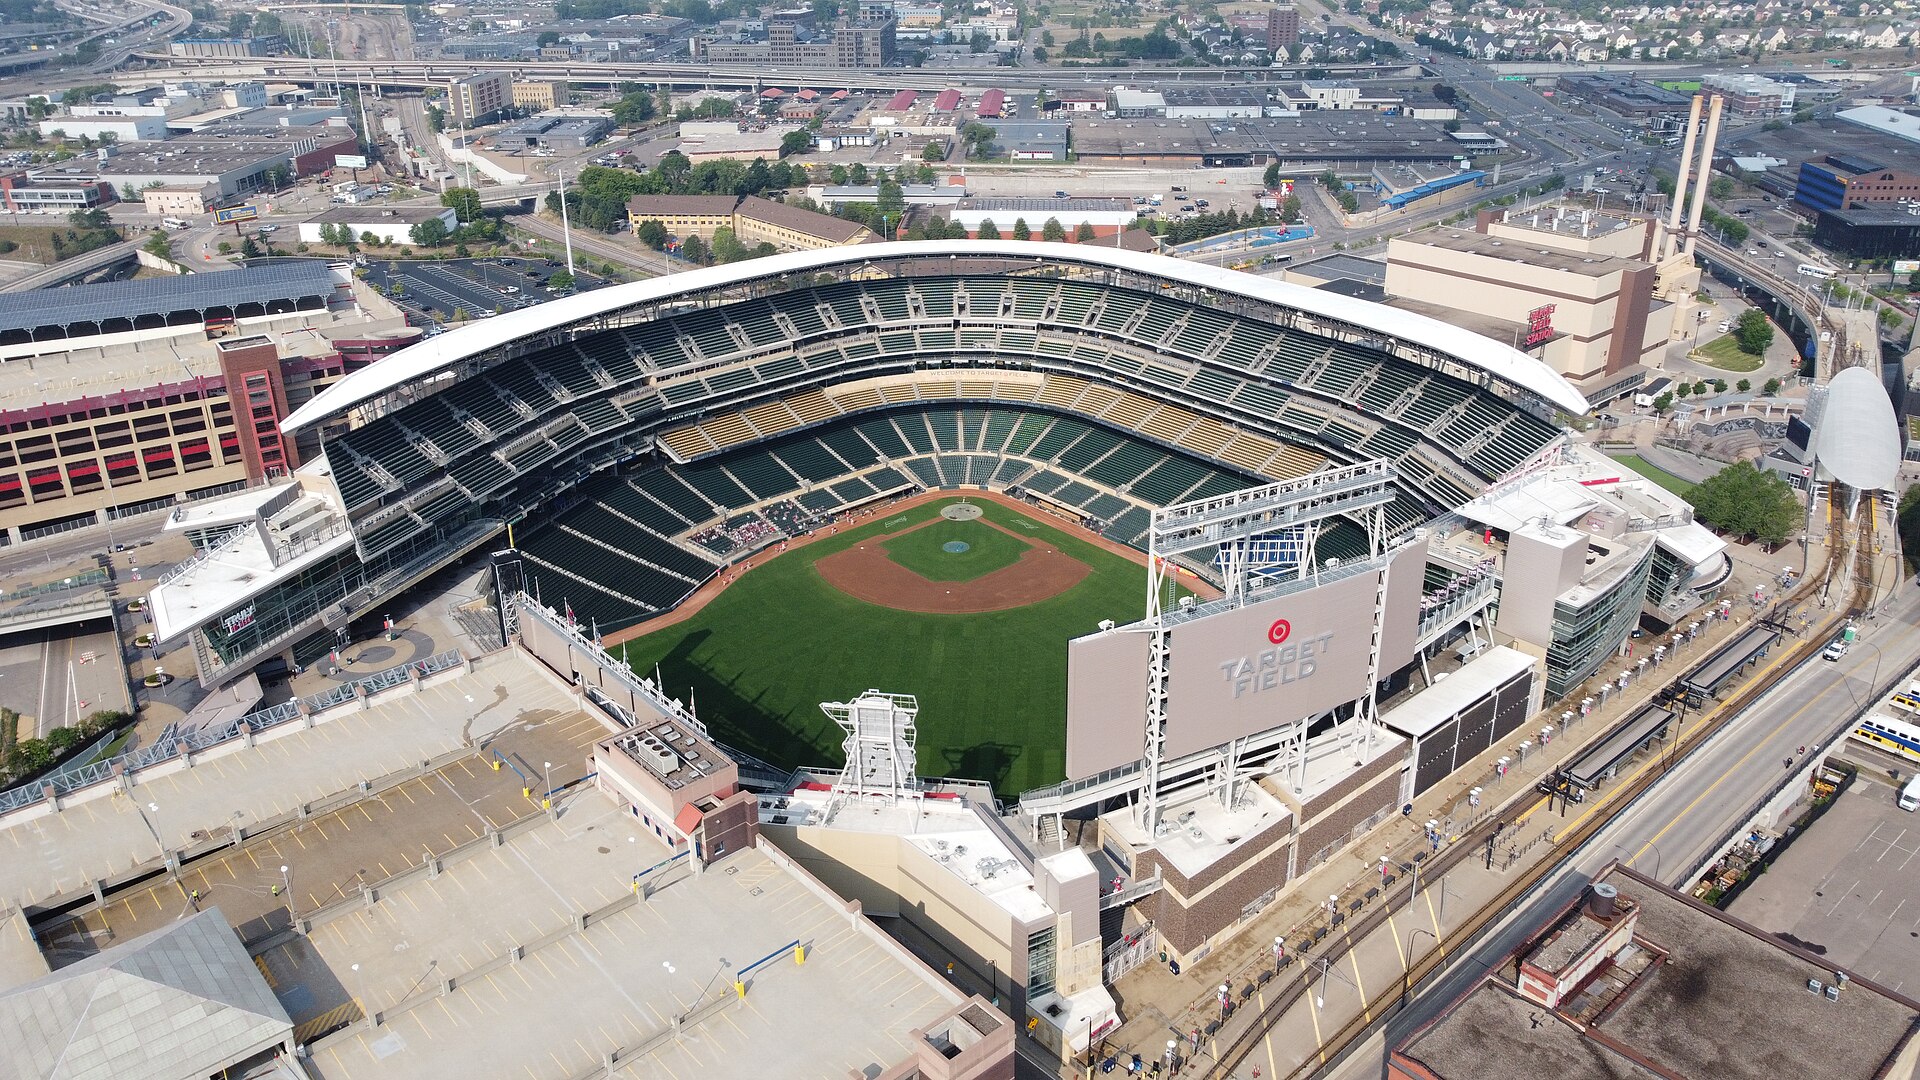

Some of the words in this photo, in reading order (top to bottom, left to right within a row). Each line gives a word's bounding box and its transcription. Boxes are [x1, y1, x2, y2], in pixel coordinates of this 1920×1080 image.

[1526, 327, 1554, 345] STATION
[225, 605, 254, 625] TRULY
[1220, 630, 1334, 681] TARGET
[1233, 658, 1316, 698] FIELD
